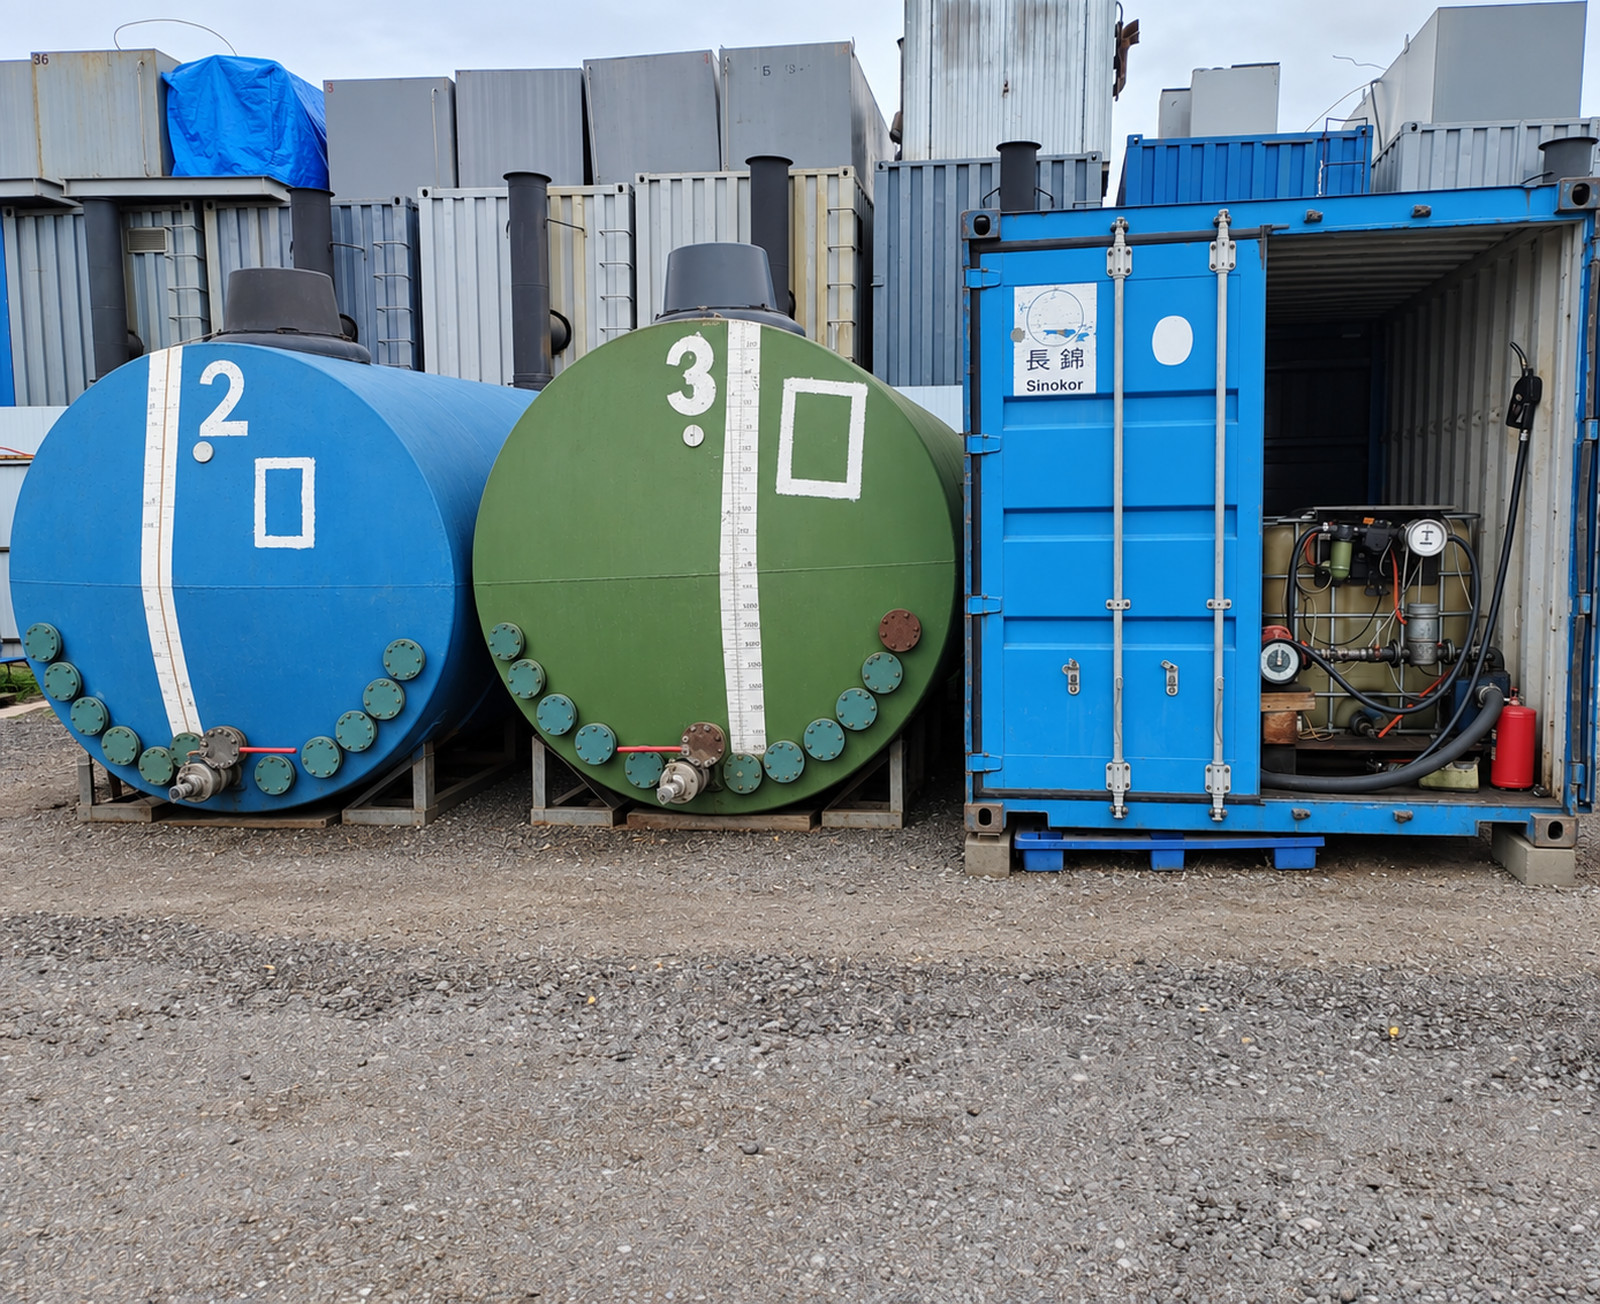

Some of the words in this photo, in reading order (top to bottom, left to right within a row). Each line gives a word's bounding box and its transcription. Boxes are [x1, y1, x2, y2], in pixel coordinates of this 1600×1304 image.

[33, 54, 49, 65] 36
[1026, 347, 1084, 371] 長錦
[666, 331, 717, 416] 3
[1026, 379, 1084, 392] Sinokor
[199, 360, 249, 437] 2
